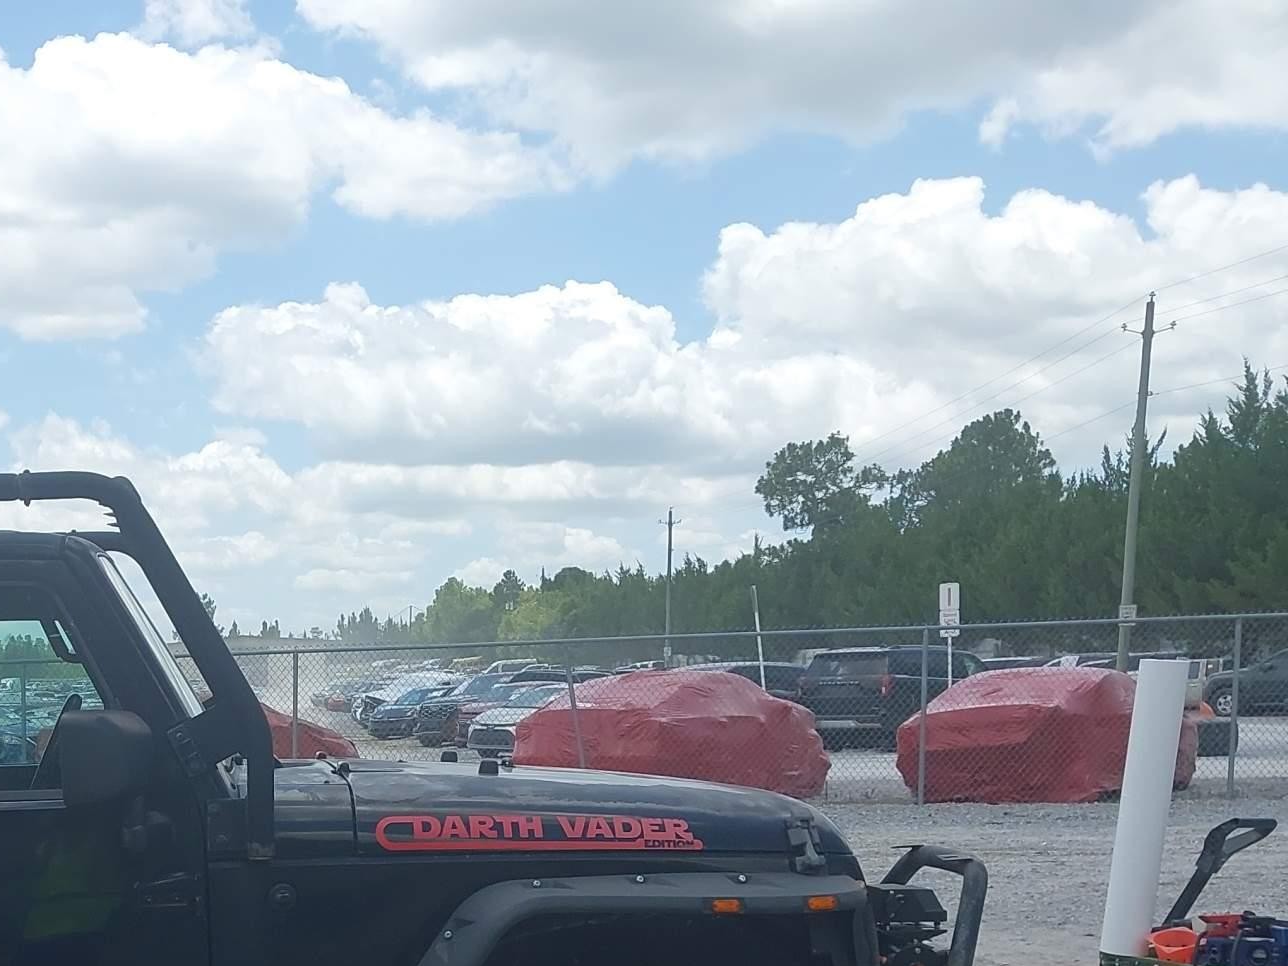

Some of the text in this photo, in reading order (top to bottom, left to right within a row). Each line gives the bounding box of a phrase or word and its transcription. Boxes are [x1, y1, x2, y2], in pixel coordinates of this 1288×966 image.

[413, 815, 694, 841] DARTH VADER
[644, 839, 695, 848] EDITION
